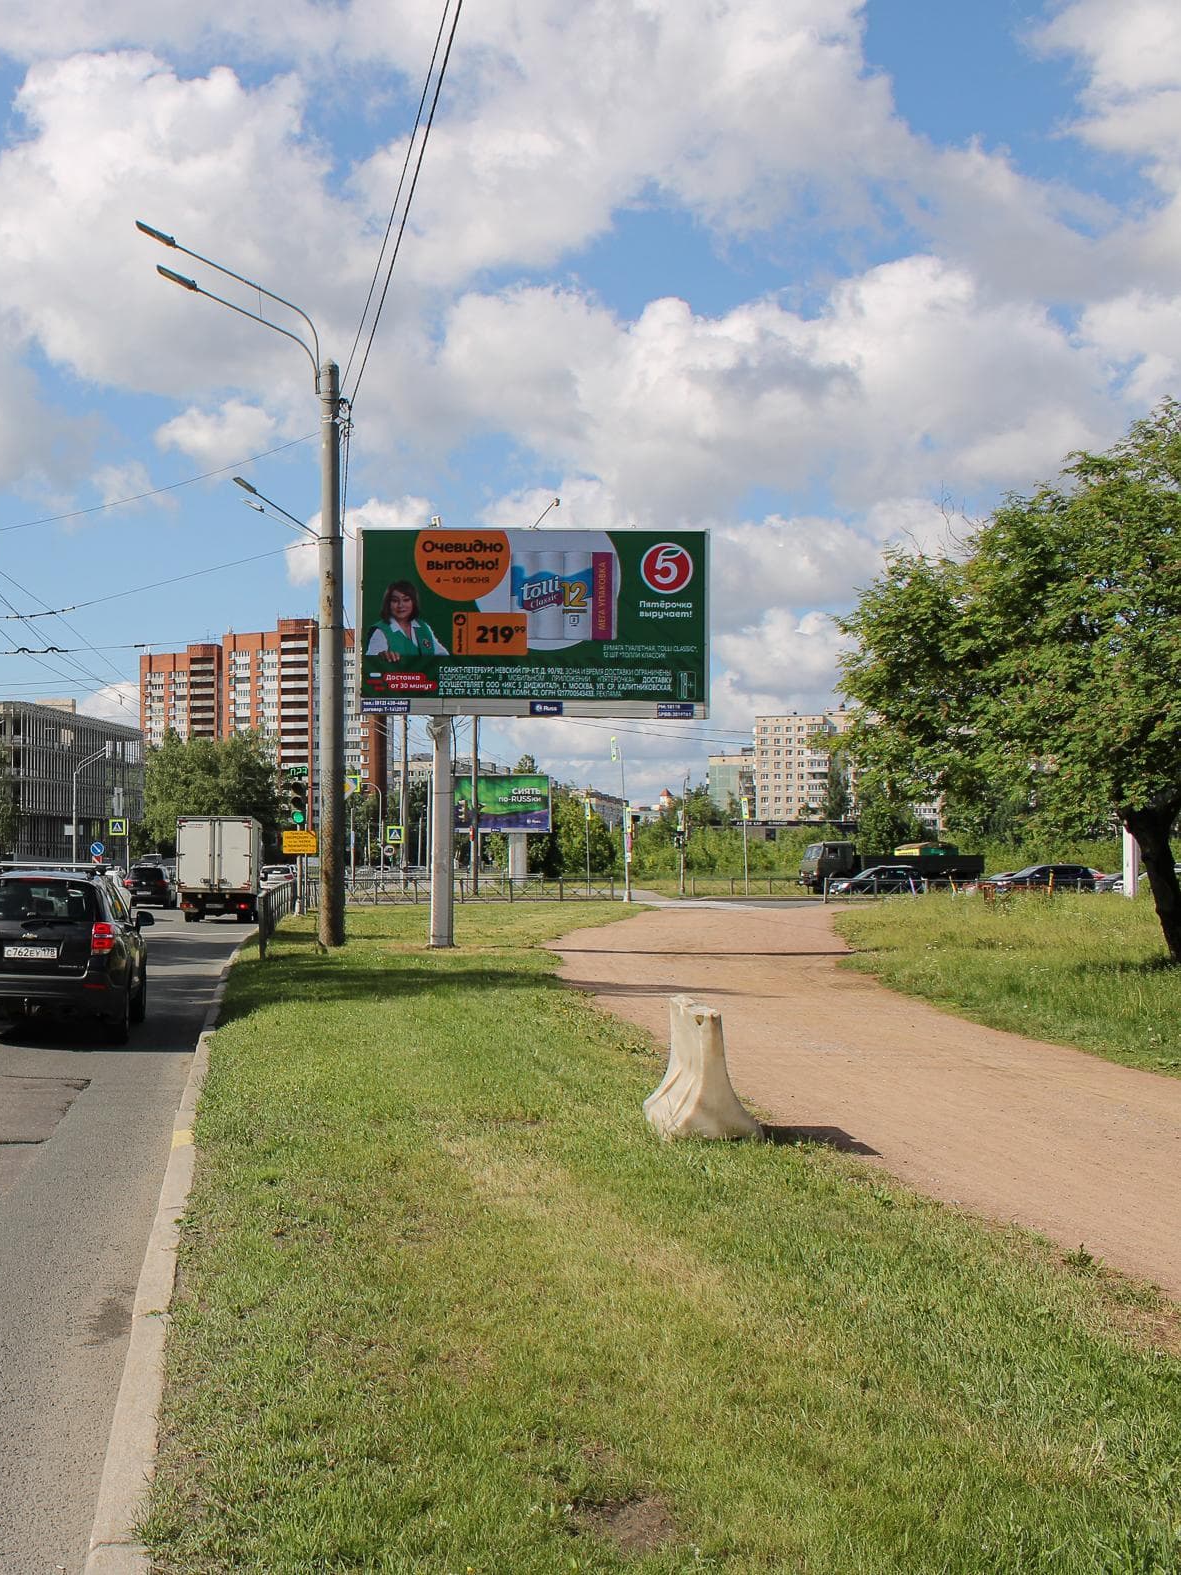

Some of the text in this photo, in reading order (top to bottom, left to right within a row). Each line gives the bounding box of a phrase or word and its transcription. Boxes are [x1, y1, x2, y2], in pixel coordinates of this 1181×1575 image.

[422, 539, 504, 553] Очевидно
[426, 556, 499, 571] выгодно!
[520, 575, 560, 601] tolli
[561, 581, 587, 607] 12
[639, 600, 693, 610] Пятёрочка
[639, 610, 692, 619] выручает!
[476, 626, 514, 643] 219
[386, 674, 420, 682] Доставка
